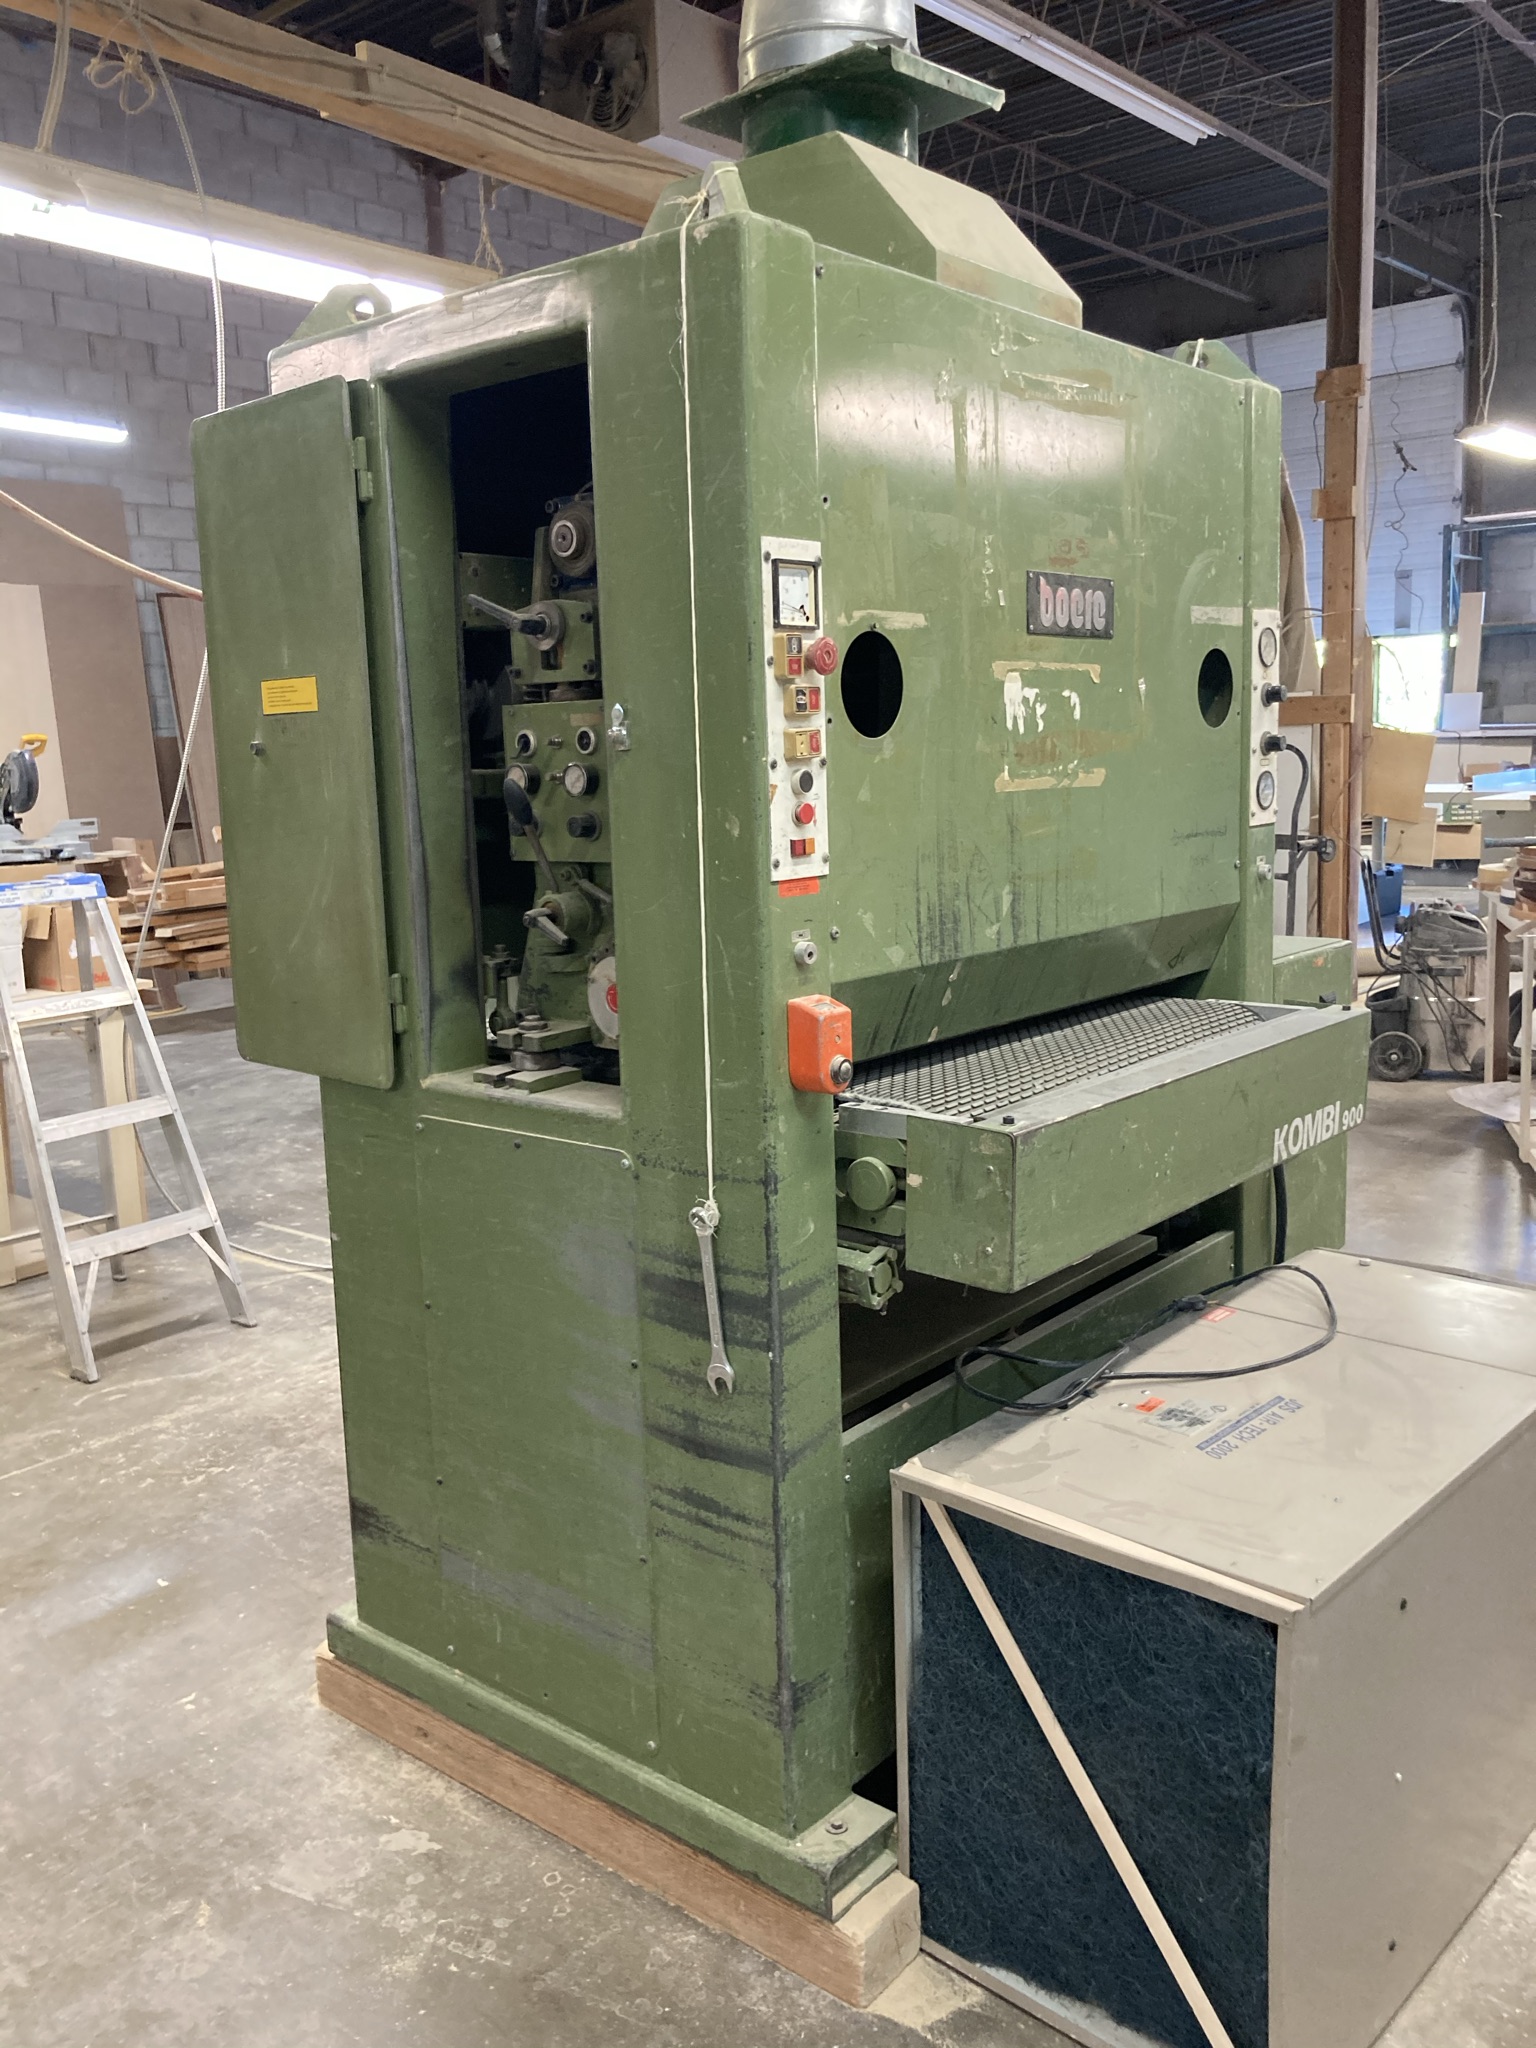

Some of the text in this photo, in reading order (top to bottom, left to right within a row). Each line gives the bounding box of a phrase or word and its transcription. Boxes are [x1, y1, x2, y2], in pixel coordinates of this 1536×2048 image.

[1039, 575, 1106, 631] boere
[1273, 1100, 1364, 1165] KOMBI 900
[1278, 1398, 1304, 1413] JDS
[1232, 1411, 1285, 1443] AIR-TECH
[1205, 1439, 1239, 1460] 2000
